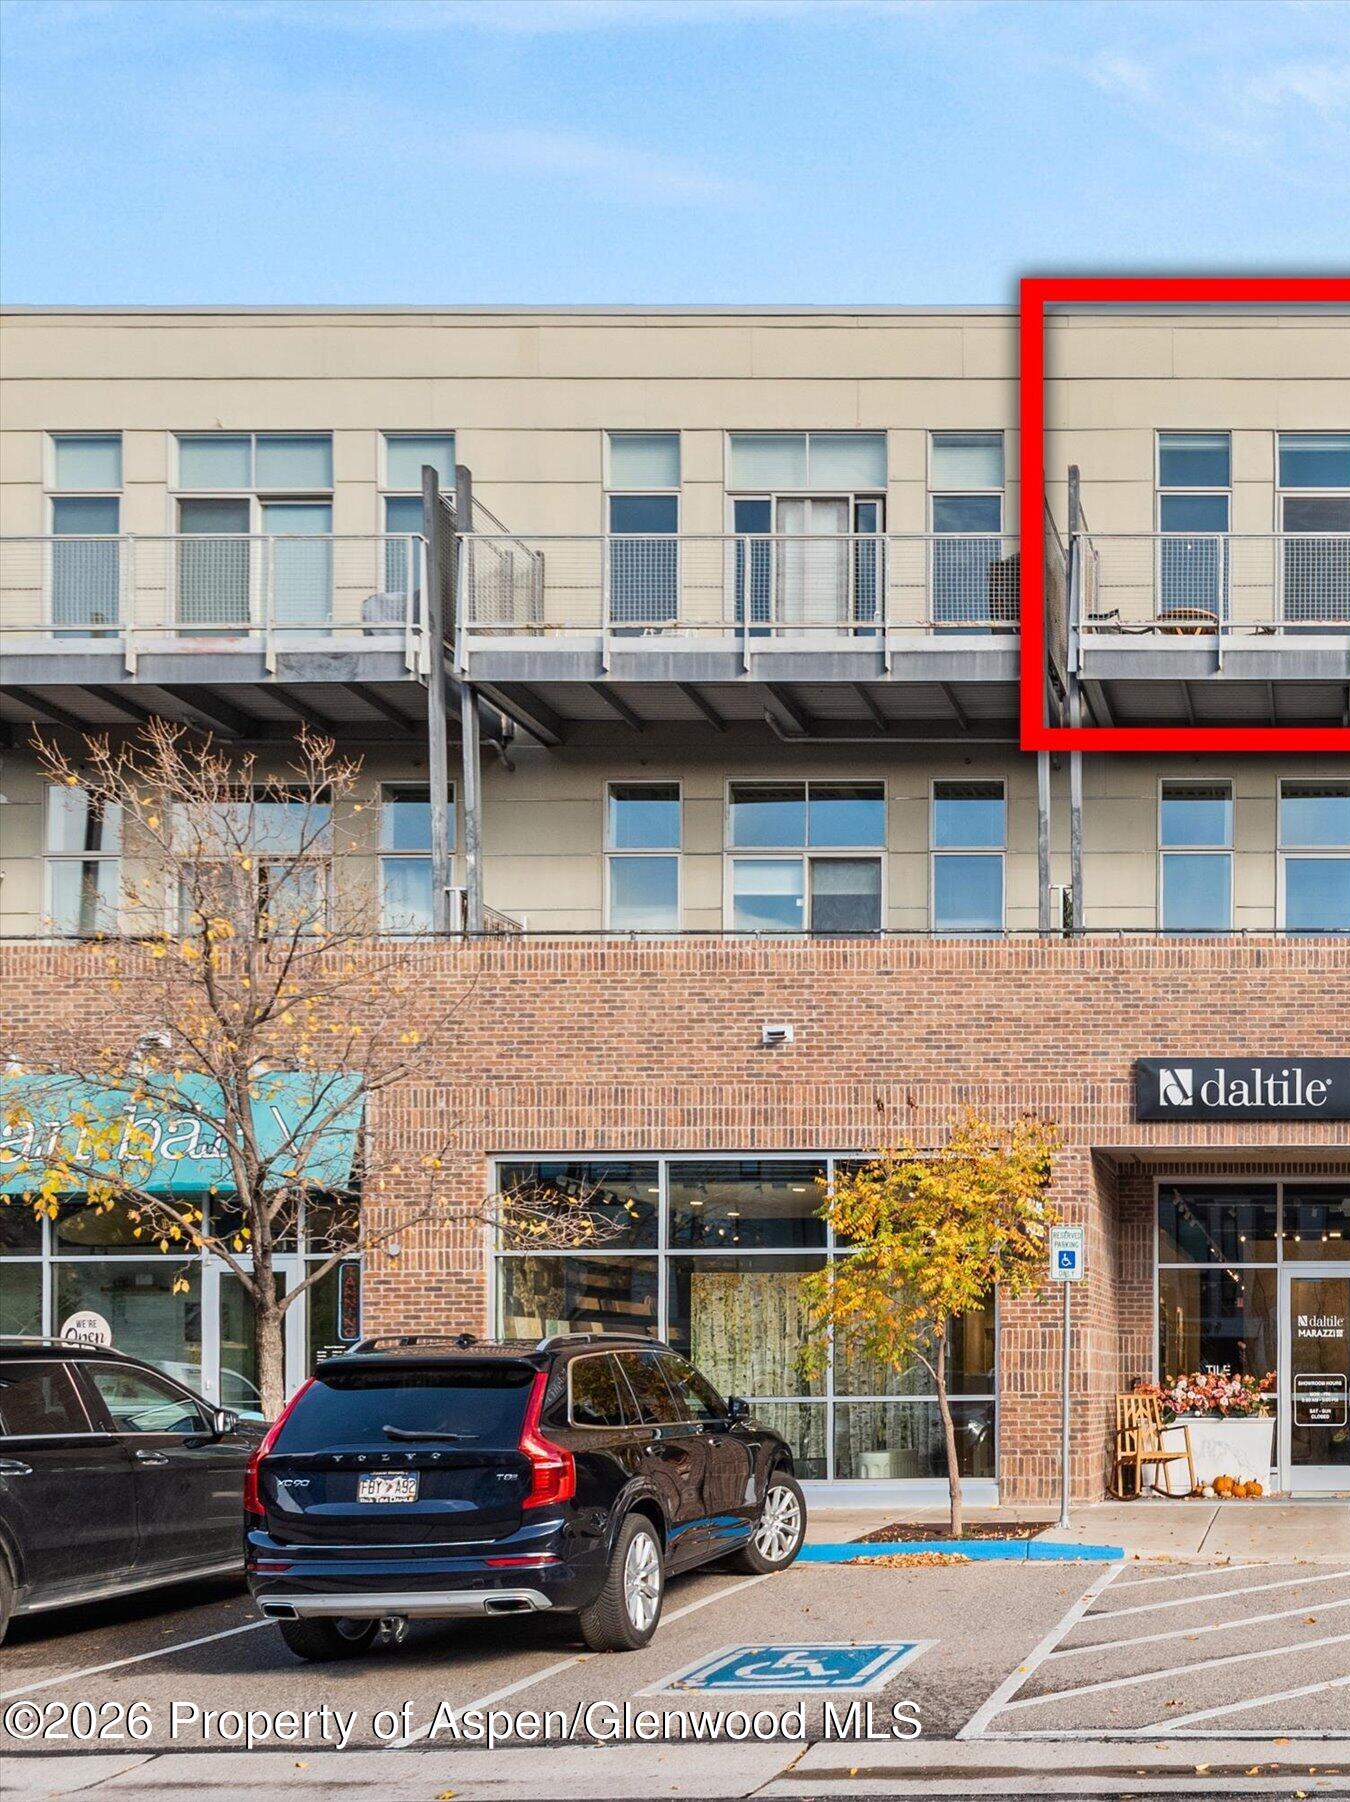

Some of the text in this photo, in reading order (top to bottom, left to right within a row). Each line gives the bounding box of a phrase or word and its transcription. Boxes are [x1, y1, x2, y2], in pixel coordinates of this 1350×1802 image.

[1053, 1231, 1081, 1239] RESERVED
[1054, 1240, 1080, 1248] PARKING
[1309, 1315, 1343, 1327] daltile
[1298, 1329, 1336, 1337] MARAZZI
[1205, 1364, 1232, 1377] TILE
[332, 1452, 441, 1462] VOLVO
[277, 1479, 311, 1488] XC90
